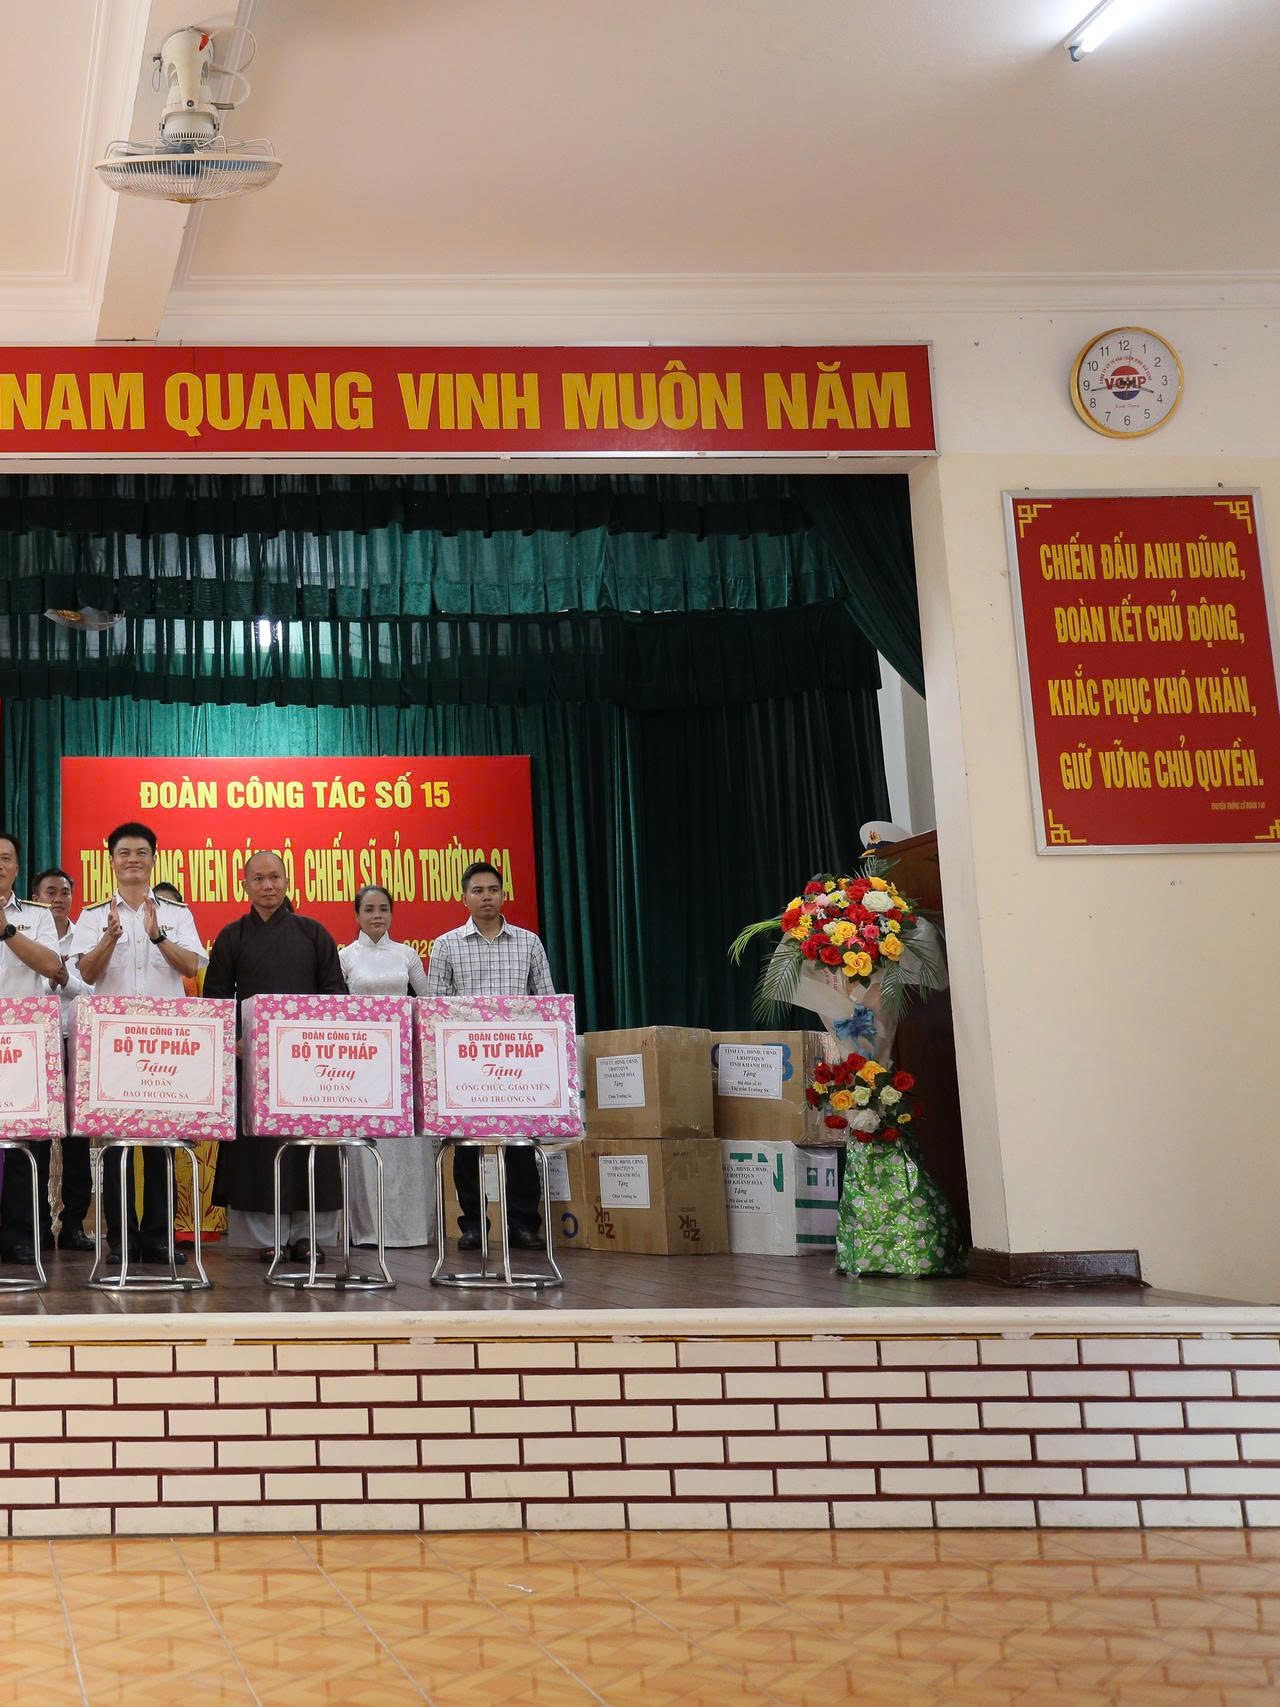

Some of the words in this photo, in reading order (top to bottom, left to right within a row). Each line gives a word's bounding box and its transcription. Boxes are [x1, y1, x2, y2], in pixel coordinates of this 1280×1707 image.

[1119, 340, 1130, 350] 12
[1142, 344, 1146, 354] 1
[1100, 346, 1109, 357] 11
[1087, 361, 1098, 371] 10
[1155, 357, 1161, 367] 2
[1083, 380, 1090, 391] 9
[1161, 375, 1168, 385] 3
[0, 373, 145, 430] NAM
[165, 372, 373, 436] QUANG
[398, 373, 540, 429] VINH
[562, 360, 743, 430] MUÔN
[764, 362, 910, 429] NĂM
[1090, 398, 1096, 408] 8
[1157, 393, 1162, 403] 4
[1105, 412, 1111, 422] 7
[1144, 409, 1150, 419] 5
[1124, 416, 1131, 426] 6
[1040, 532, 1096, 580] CHIẾN
[1101, 532, 1138, 579] ĐẤU
[1144, 543, 1183, 578] ANH
[1186, 535, 1245, 580] DŨNG,
[1054, 599, 1106, 643] ĐOÀN
[1109, 594, 1142, 642] KẾT
[1146, 590, 1183, 641] CHỦ
[1187, 597, 1244, 647] ĐỘNG,
[1048, 664, 1100, 716] KHẮC
[1102, 678, 1151, 722] PHỤC
[1154, 670, 1192, 714] KHÓ
[1195, 668, 1256, 716] KHĂN,
[1060, 743, 1092, 789] GIỮ
[1099, 740, 1151, 788] VỮNG
[1154, 735, 1193, 788] CHỦ
[1195, 738, 1264, 791] QUYỀN.
[140, 776, 217, 808] ĐOÀN
[227, 776, 304, 808] CÔNG
[312, 776, 365, 808] TÁC
[375, 772, 411, 808] SỐ
[421, 782, 450, 807] 15
[81, 838, 118, 902] THĂ
[188, 838, 228, 902] VIÊN
[305, 832, 356, 902] CHIẾN
[360, 838, 376, 888] SĨ
[381, 831, 415, 902] ĐẢO
[124, 1026, 148, 1034] ĐOÀN
[150, 1027, 173, 1036] CÔNG
[175, 1027, 191, 1037] TÁC
[302, 1031, 325, 1040] ĐOÀN
[327, 1031, 350, 1040] CÔNG
[352, 1032, 368, 1041] TÁC
[468, 1032, 491, 1041] ĐOÀN
[493, 1032, 516, 1041] CÔNG
[518, 1032, 533, 1041] TÁC
[113, 1036, 134, 1056] BỘ
[138, 1039, 158, 1054] TƯ
[160, 1038, 201, 1056] PHÁP
[291, 1042, 311, 1061] BỘ
[316, 1044, 335, 1059] TƯ
[338, 1043, 378, 1060] PHÁP
[458, 1042, 478, 1061] BỘ
[482, 1043, 502, 1058] TƯ
[505, 1041, 544, 1058] PHÁP
[136, 1059, 177, 1076] Tặng
[314, 1064, 356, 1081] Tặng
[481, 1063, 523, 1080] Tặng
